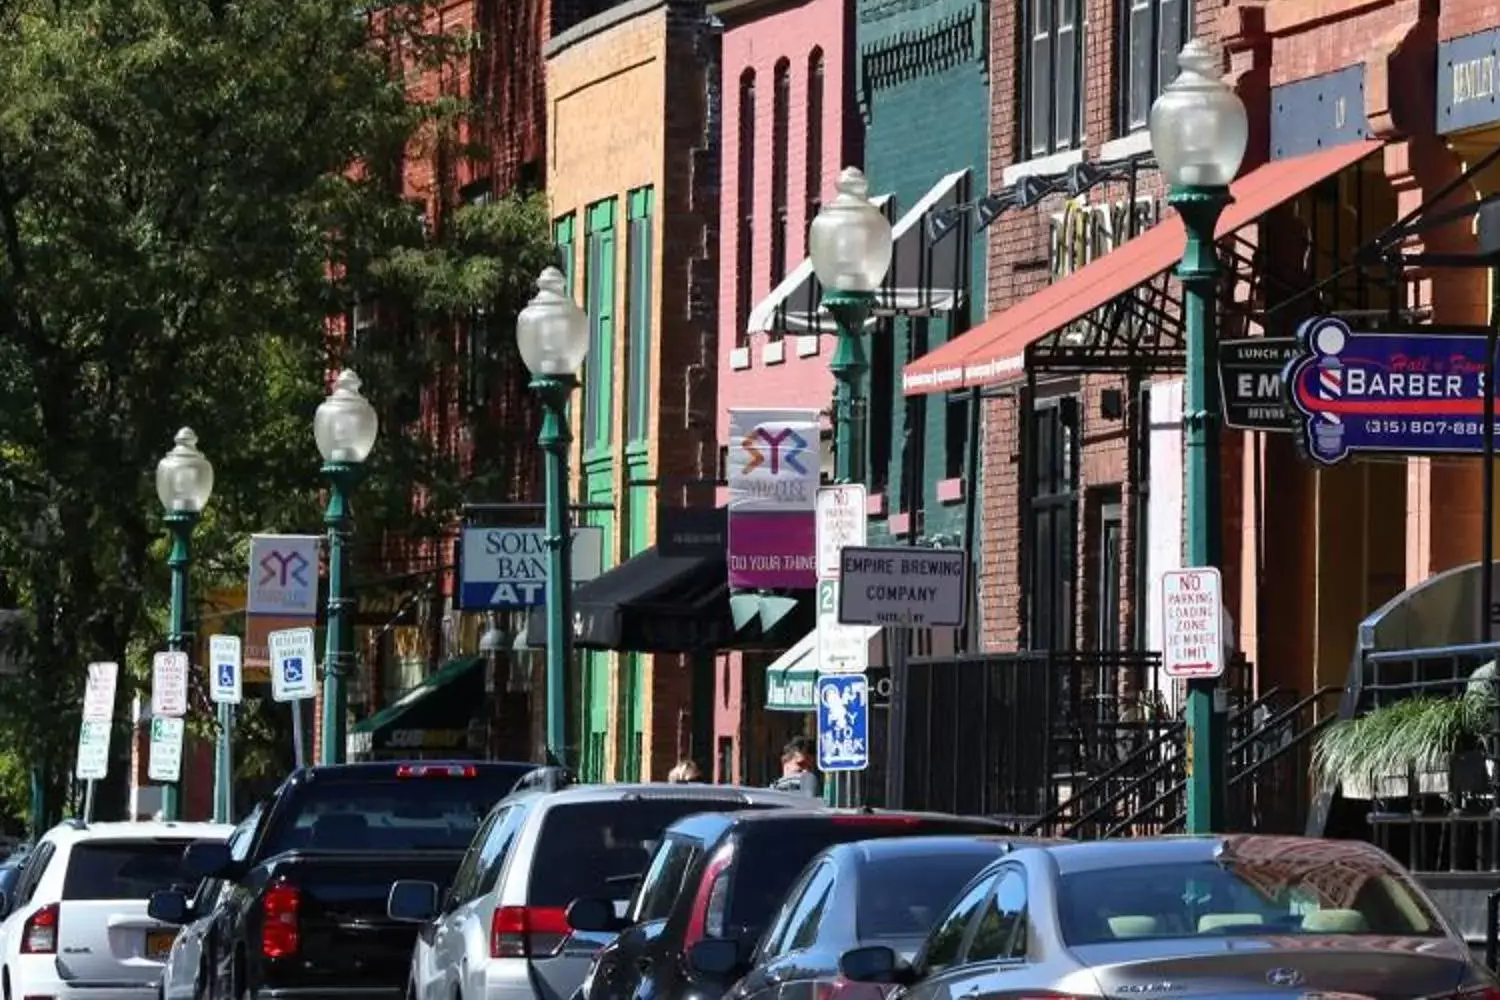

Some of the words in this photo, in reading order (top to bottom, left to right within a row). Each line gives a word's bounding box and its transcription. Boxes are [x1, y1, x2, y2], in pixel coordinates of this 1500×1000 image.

[1238, 348, 1278, 359] LUNCH
[1347, 369, 1462, 397] BARBER
[1366, 419, 1406, 435] (315)
[486, 531, 578, 555] SOLV
[498, 556, 547, 579] BAN
[731, 555, 747, 571] DO
[749, 556, 781, 573] YOUR
[845, 559, 893, 575] EMPIRE
[901, 559, 961, 577] BREWING
[1180, 574, 1201, 591] NO
[489, 583, 545, 604] AT
[866, 585, 937, 601] COMPANY
[1167, 591, 1213, 605] PARKING
[1168, 606, 1214, 618] LOADING
[1175, 619, 1206, 632] ZONE
[1175, 646, 1207, 660] LIMIT
